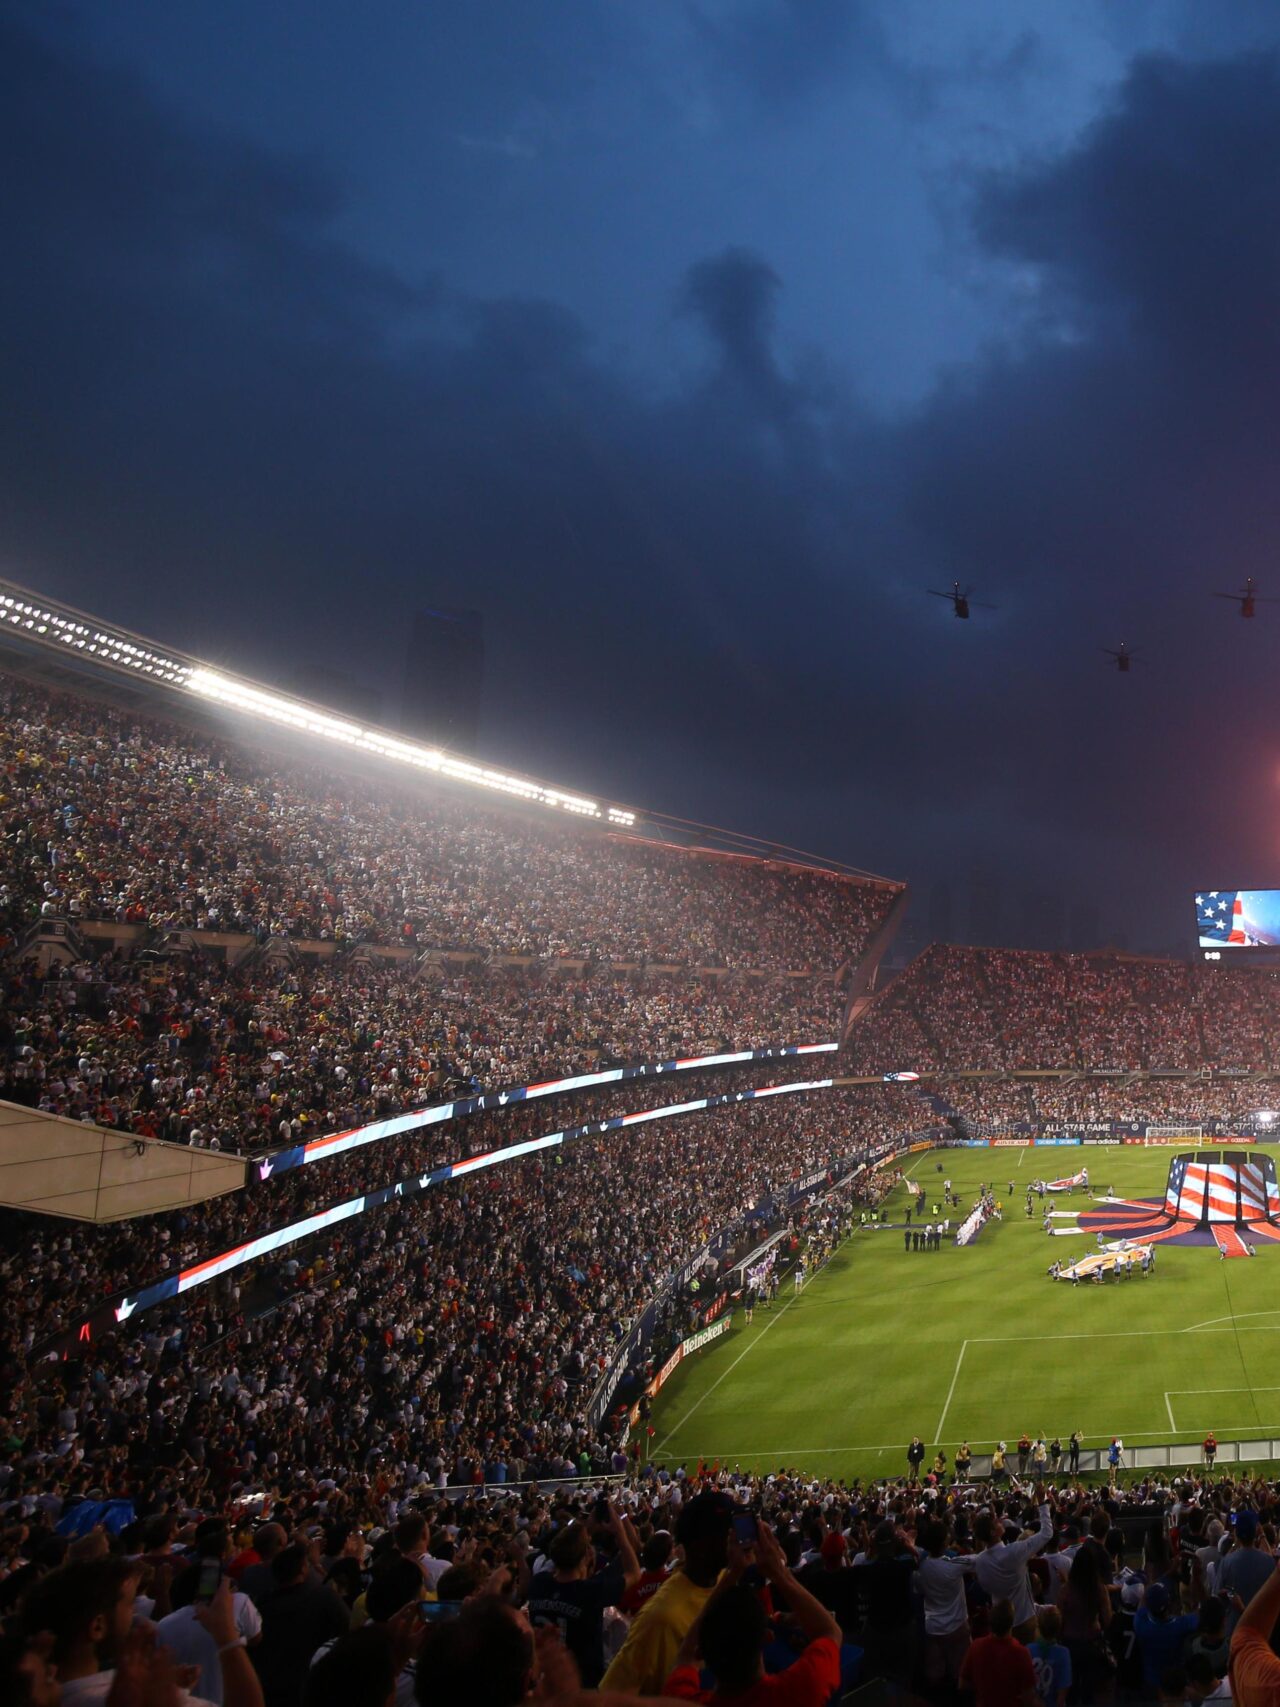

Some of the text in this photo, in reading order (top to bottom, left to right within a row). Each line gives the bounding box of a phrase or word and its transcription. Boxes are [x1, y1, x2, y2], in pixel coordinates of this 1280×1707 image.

[1045, 1123, 1085, 1132] ALL-STAR
[1087, 1123, 1111, 1132] GAME
[682, 1323, 723, 1357] Heineken
[1122, 1630, 1137, 1660] 7
